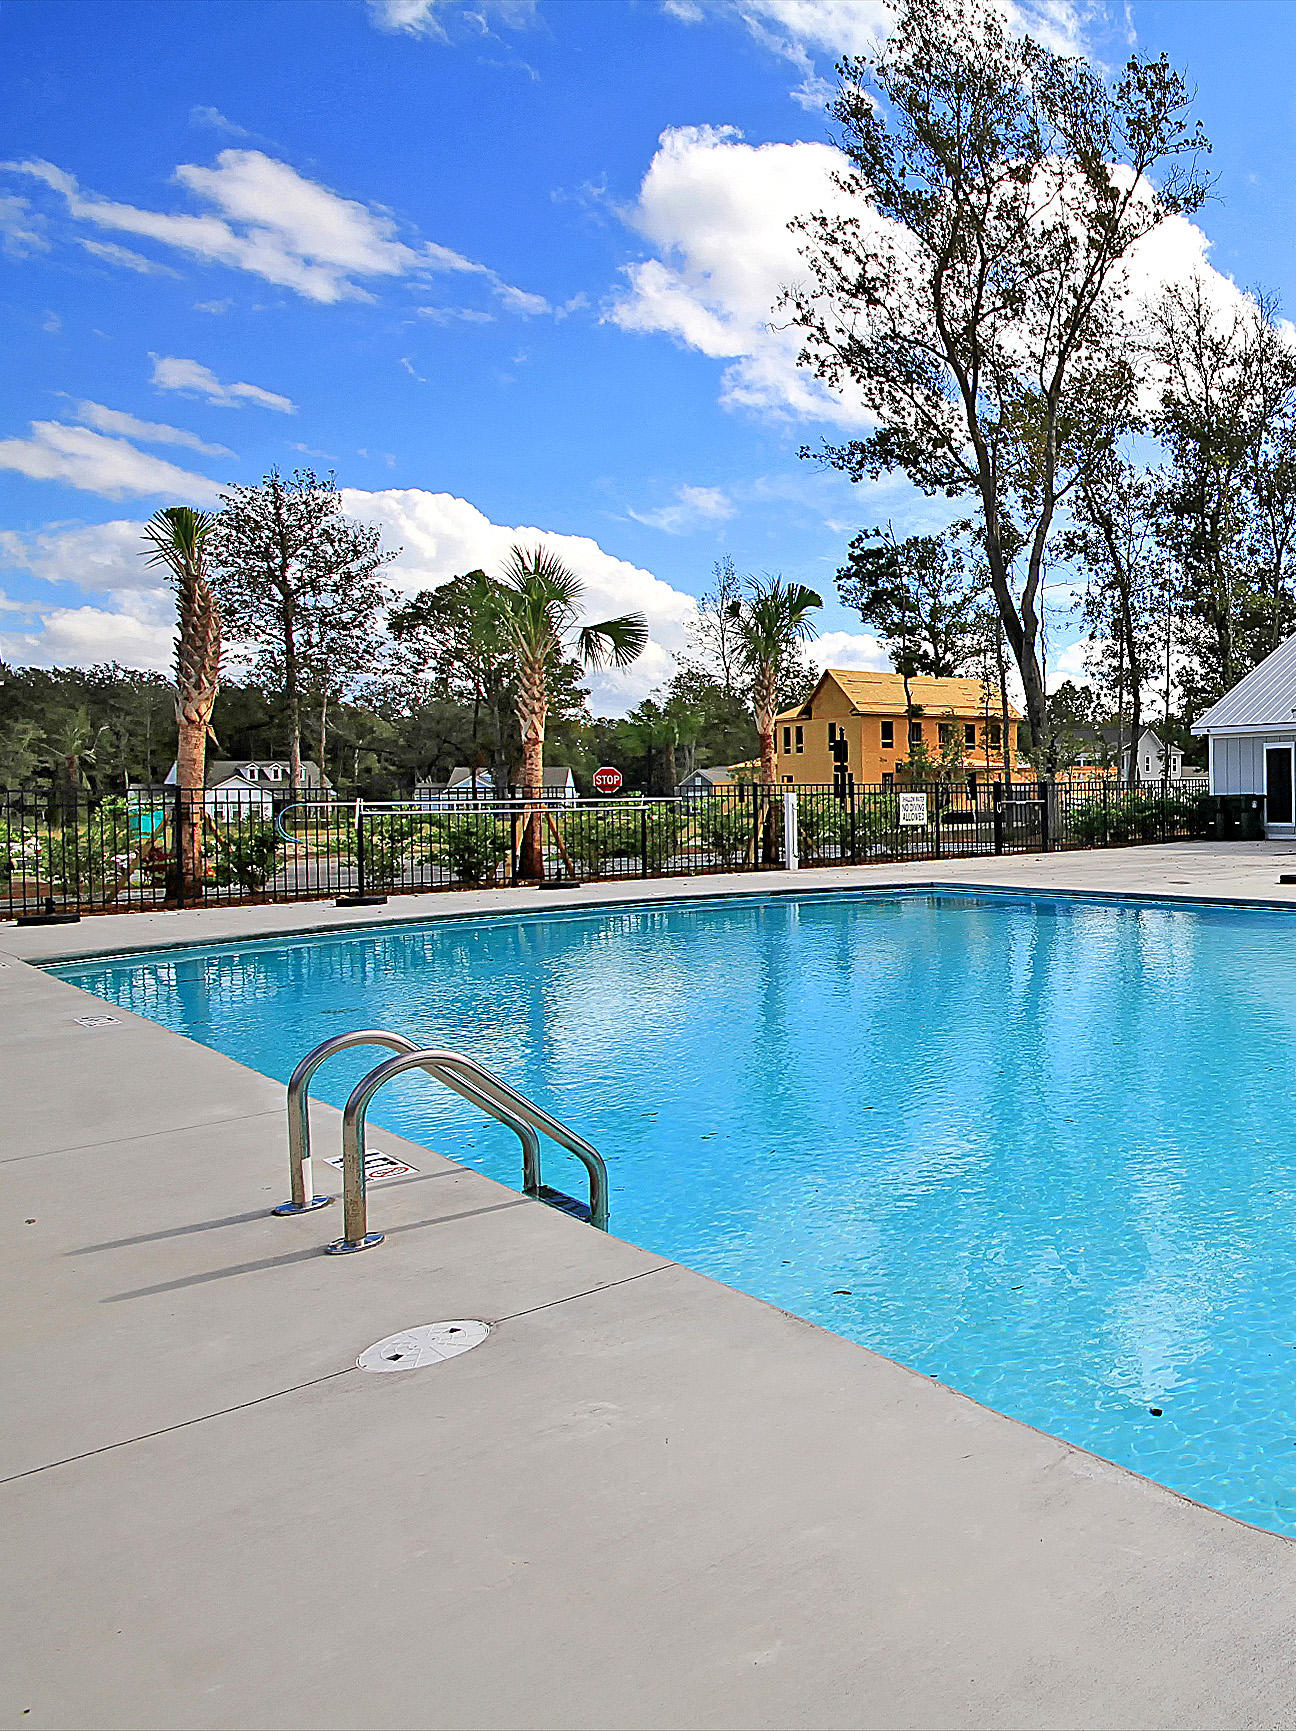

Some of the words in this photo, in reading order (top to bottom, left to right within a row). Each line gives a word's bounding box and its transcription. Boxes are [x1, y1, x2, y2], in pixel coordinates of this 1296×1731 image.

[595, 775, 620, 785] STOP
[901, 803, 909, 812] NO
[909, 803, 925, 812] DIVING
[902, 812, 925, 822] ALLOWED
